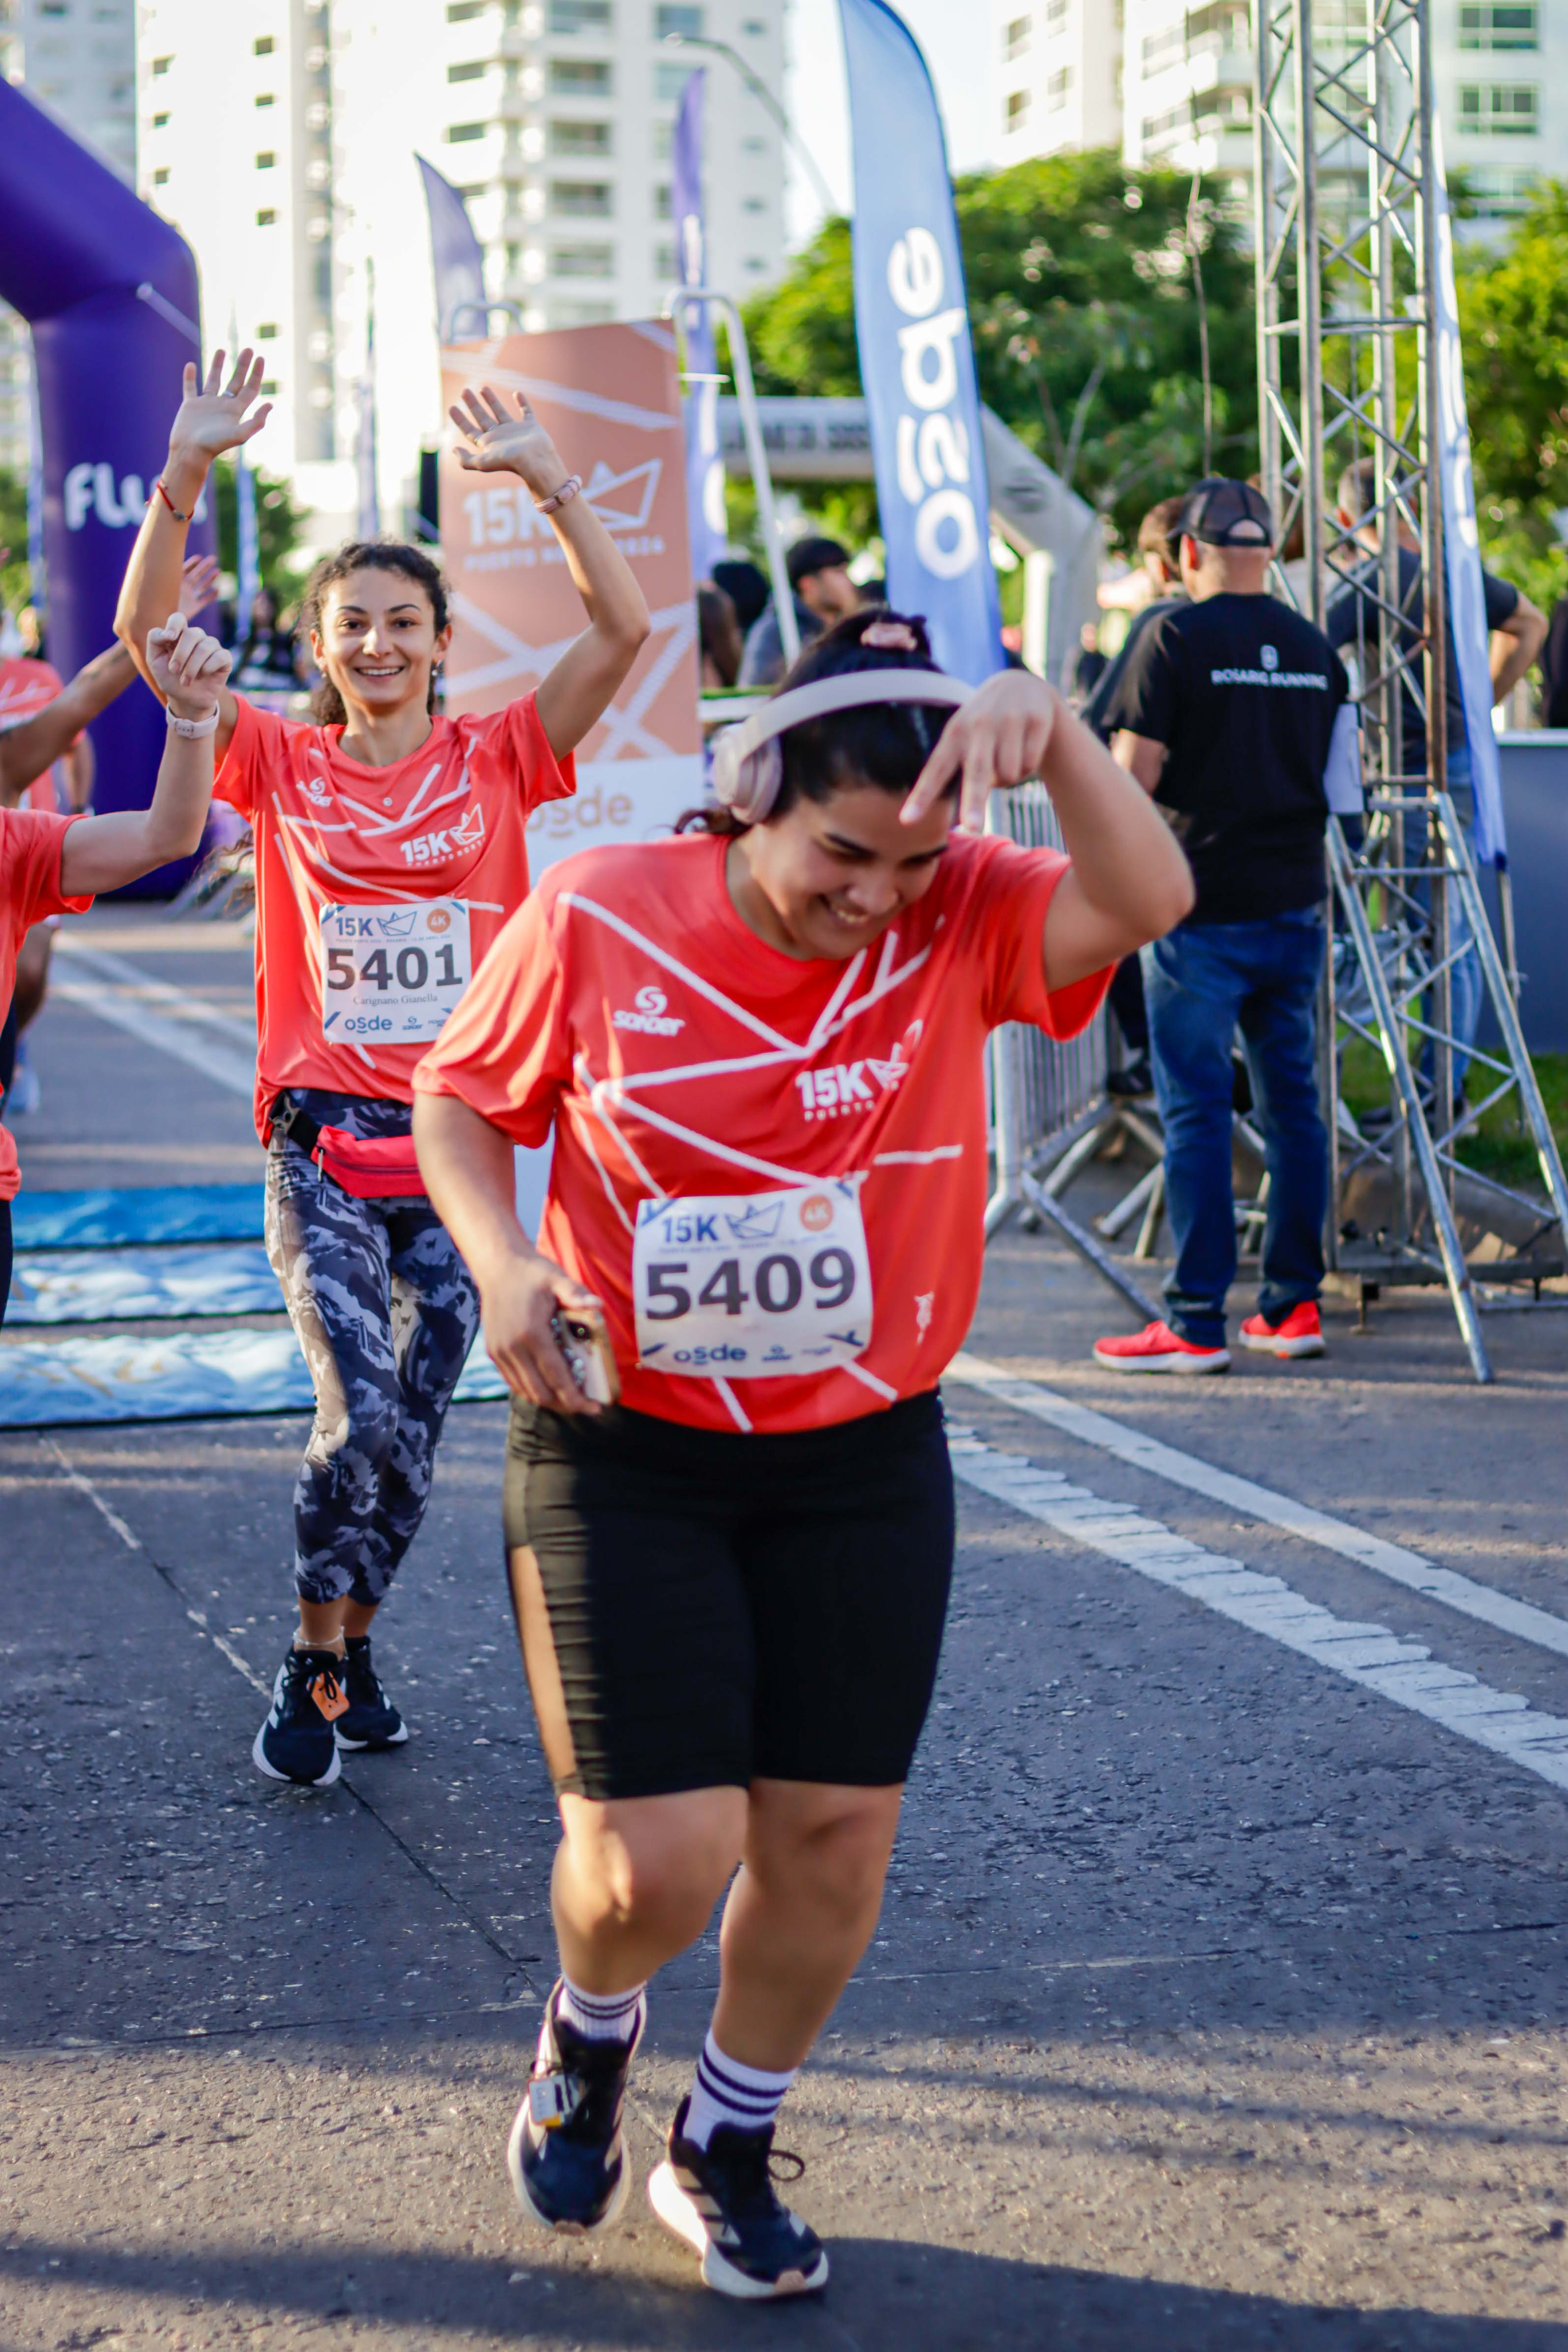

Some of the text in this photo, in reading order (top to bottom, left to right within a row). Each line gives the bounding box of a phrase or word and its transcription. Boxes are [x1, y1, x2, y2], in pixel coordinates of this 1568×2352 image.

[526, 785, 633, 833] osde
[400, 830, 452, 864] 15K
[335, 917, 374, 937] 15K
[430, 915, 447, 926] 4K
[327, 943, 463, 991] 5401
[353, 994, 438, 1006] Carignano Gianella
[345, 1015, 393, 1031] osde
[795, 1060, 874, 1109] 15K
[662, 1213, 719, 1243] 15K
[645, 1245, 856, 1321] 5409
[673, 1343, 748, 1363] osde
